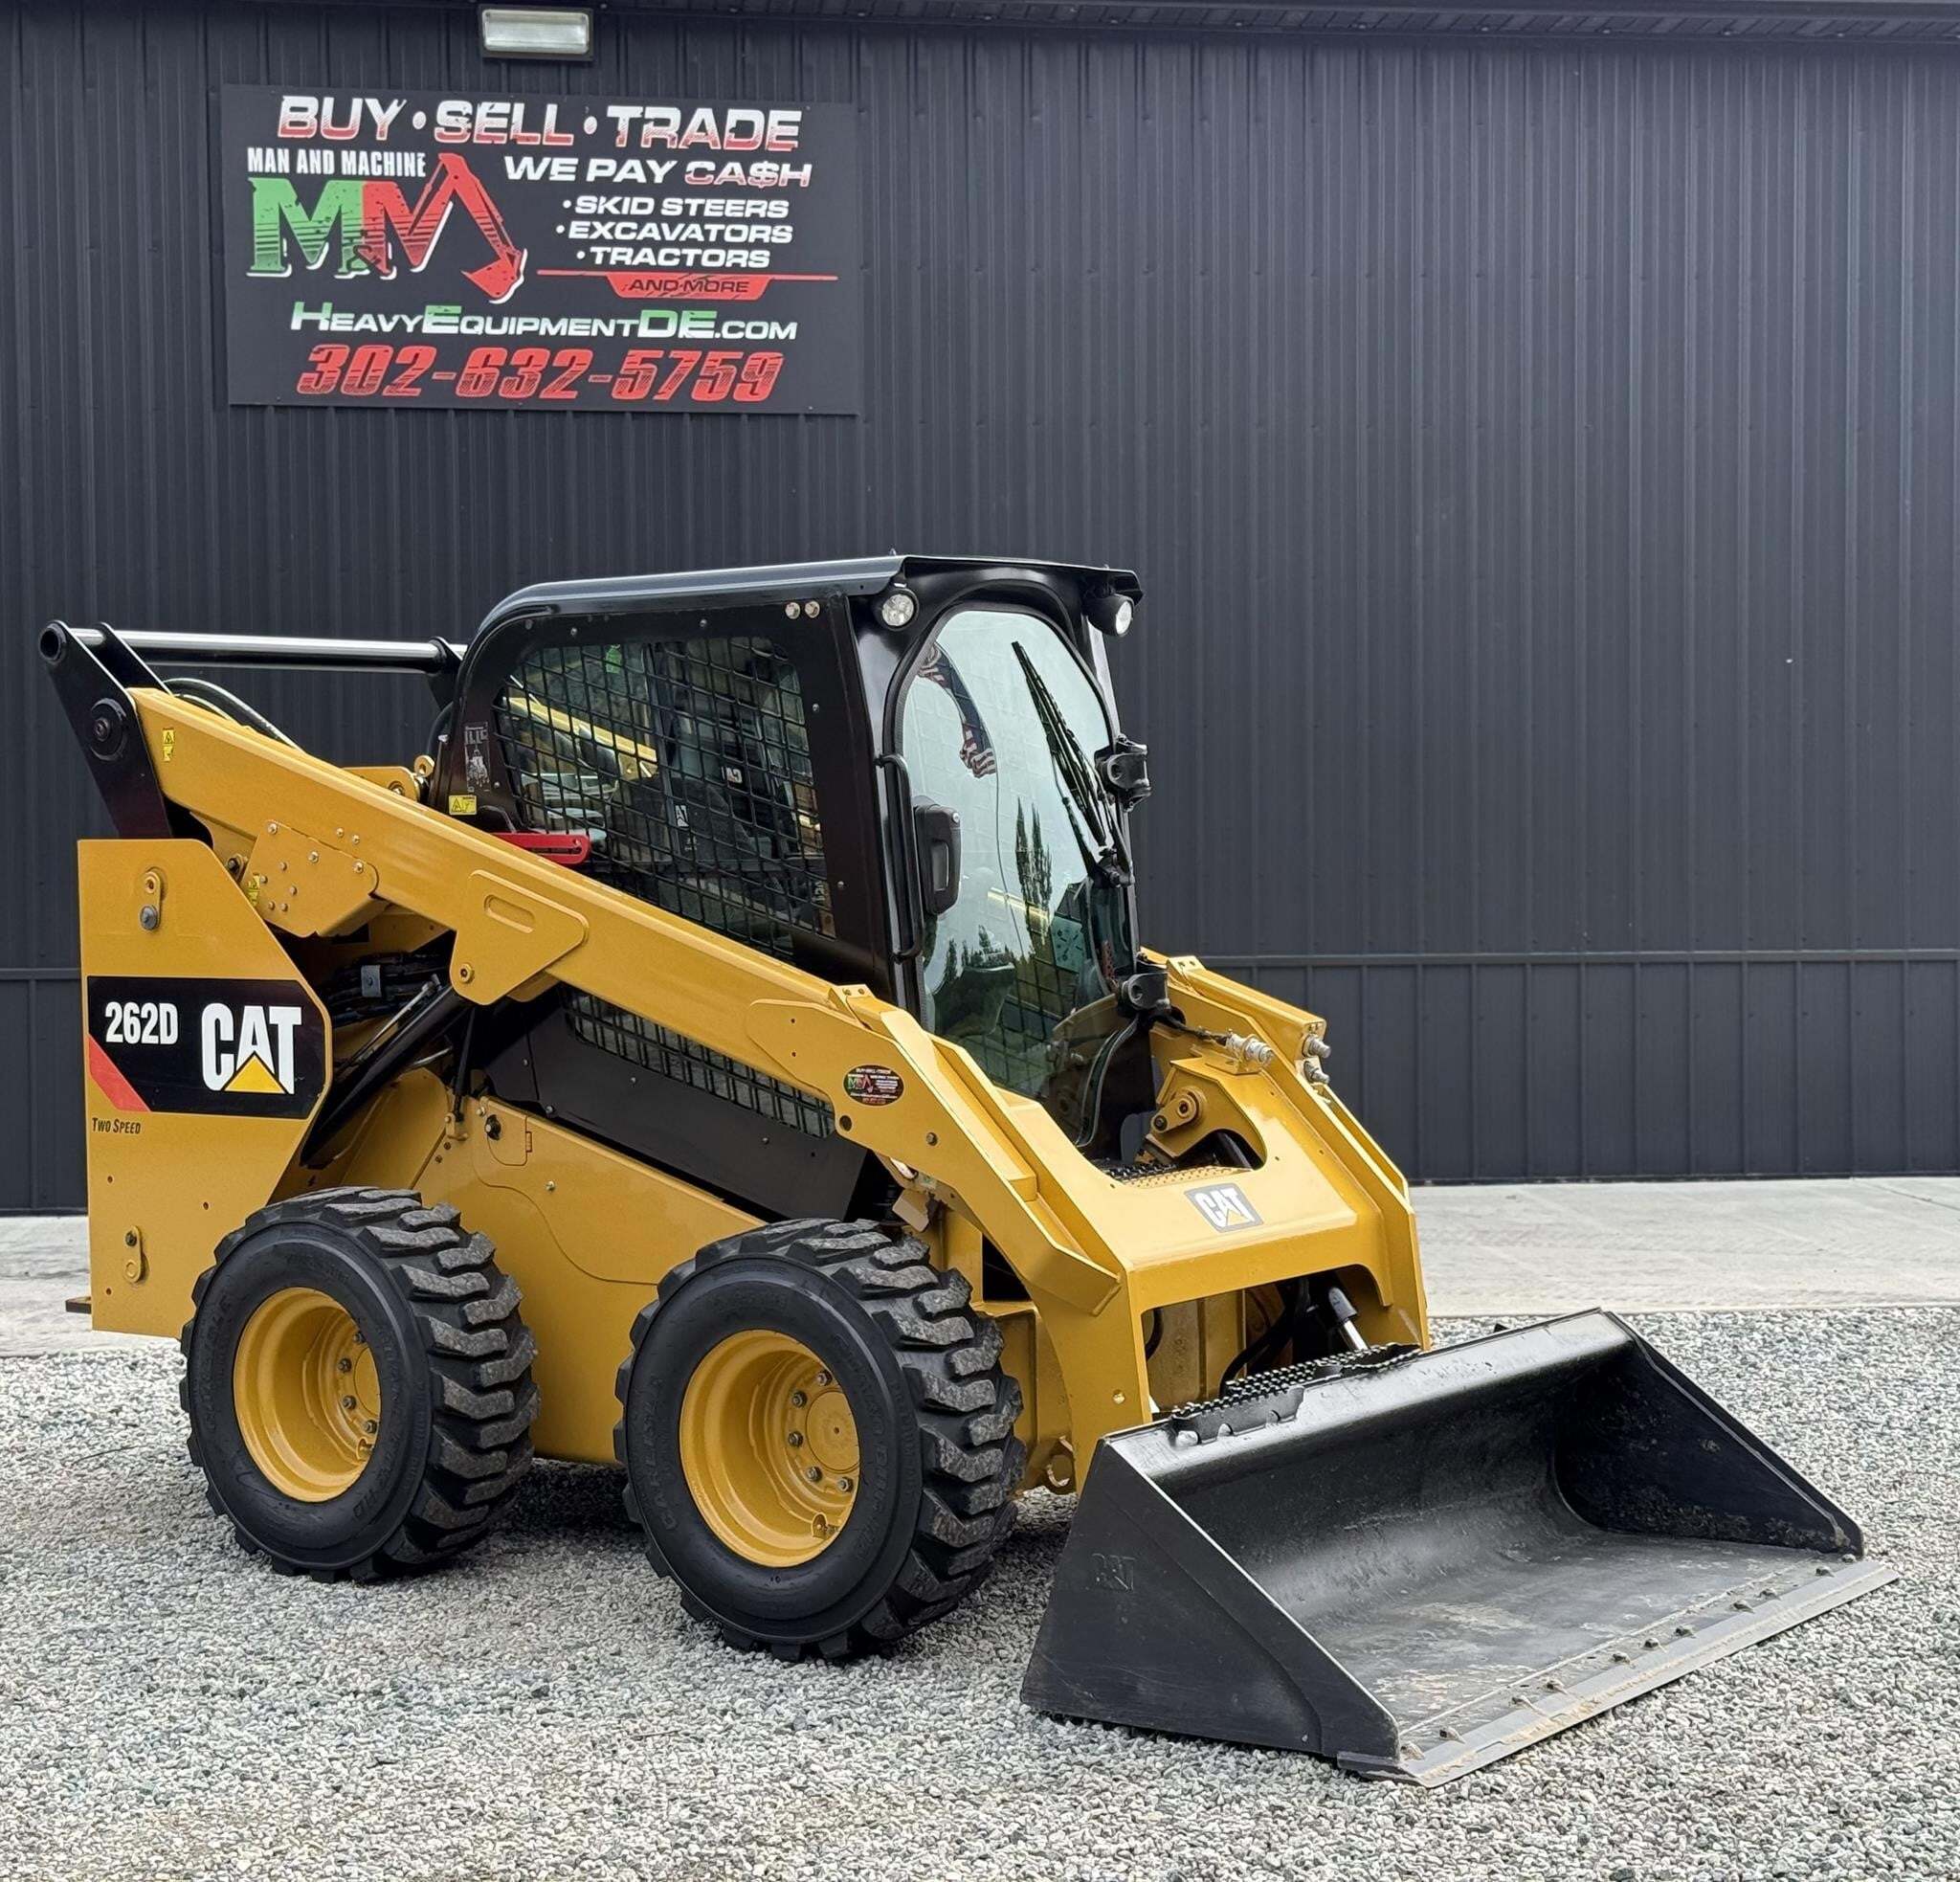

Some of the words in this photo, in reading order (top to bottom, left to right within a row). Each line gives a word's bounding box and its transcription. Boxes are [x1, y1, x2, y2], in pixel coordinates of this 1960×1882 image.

[278, 96, 407, 140] BUY
[434, 100, 574, 146] SELL
[606, 104, 802, 151] TRADE
[247, 146, 290, 173] MAN
[296, 149, 335, 175] AND
[341, 150, 426, 177] MACHINE
[504, 155, 578, 181] WE
[586, 158, 678, 184] PAY
[684, 160, 813, 189] CA$H
[575, 195, 655, 215] SKID
[660, 198, 790, 218] STEERS
[568, 220, 793, 244] EXCAVATORS
[590, 246, 770, 268] TRACTORS
[296, 343, 785, 402] 302-632-5759
[104, 1001, 179, 1045] 262D
[201, 1002, 302, 1095] CAT
[1194, 1187, 1256, 1228] CAT
